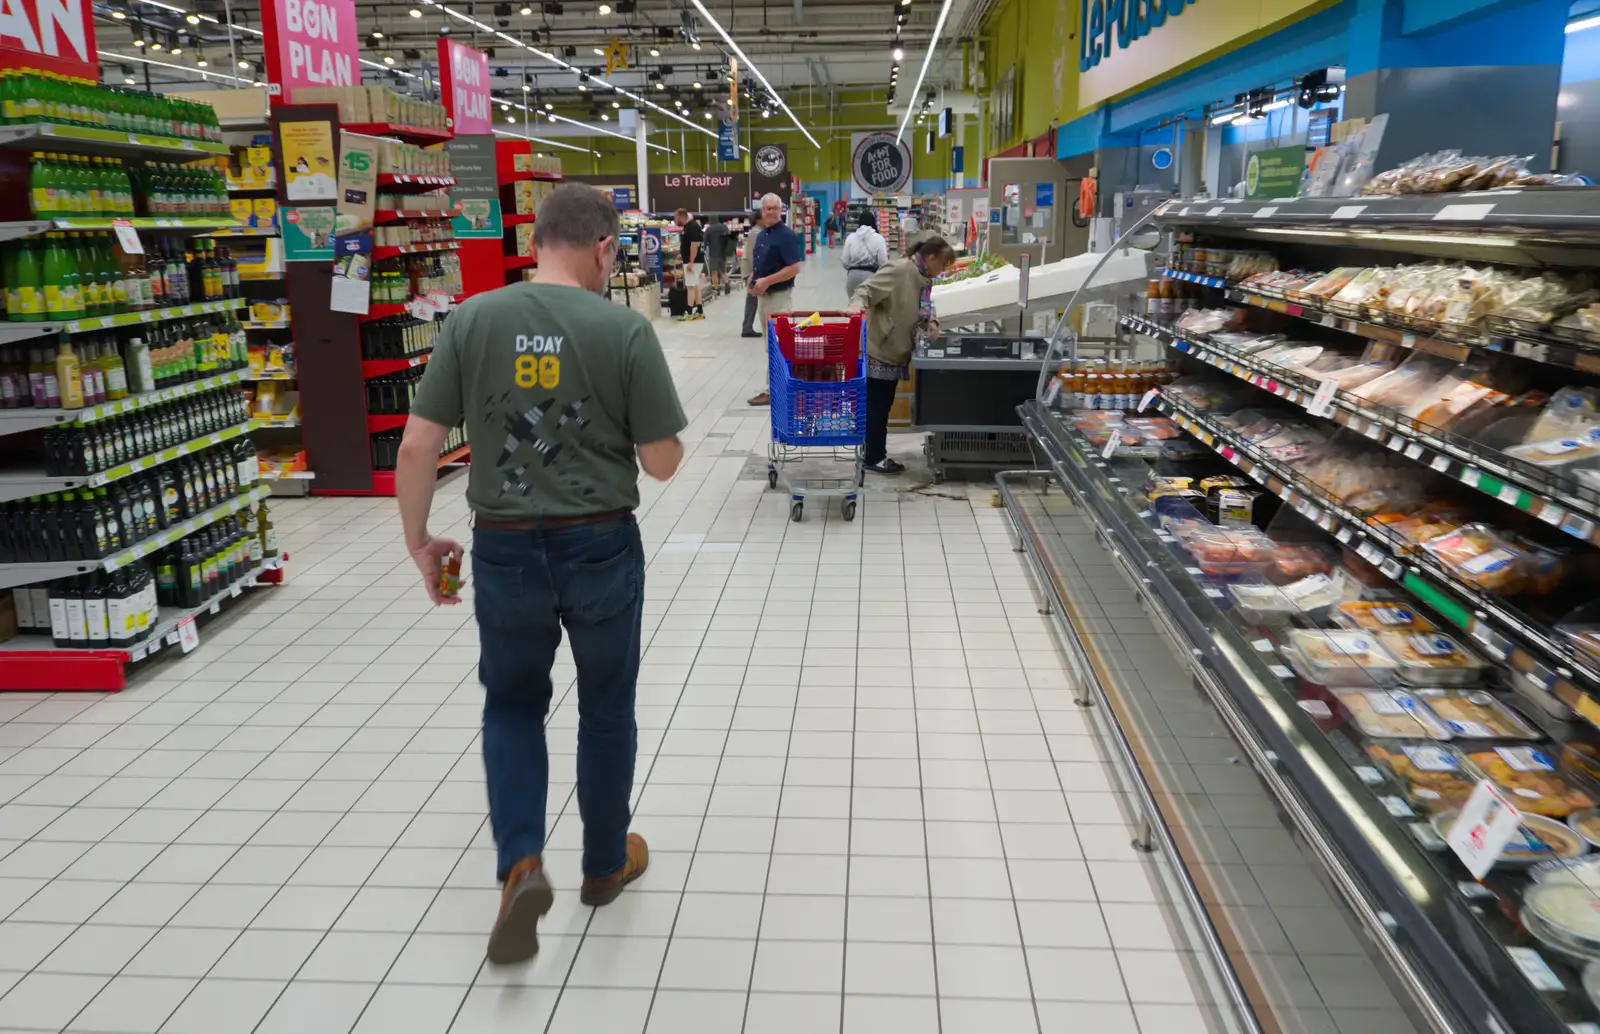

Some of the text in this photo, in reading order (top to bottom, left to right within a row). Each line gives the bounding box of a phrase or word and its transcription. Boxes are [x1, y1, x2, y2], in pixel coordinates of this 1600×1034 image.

[285, 0, 338, 43] BON
[289, 42, 350, 86] PLAN
[454, 53, 480, 87] BON
[456, 89, 488, 121] PLAN
[664, 174, 733, 187] Le Traiteur
[871, 158, 891, 173] FOR
[871, 167, 898, 185] FOOD
[515, 334, 564, 354] D-DAY
[515, 354, 561, 389] 80
